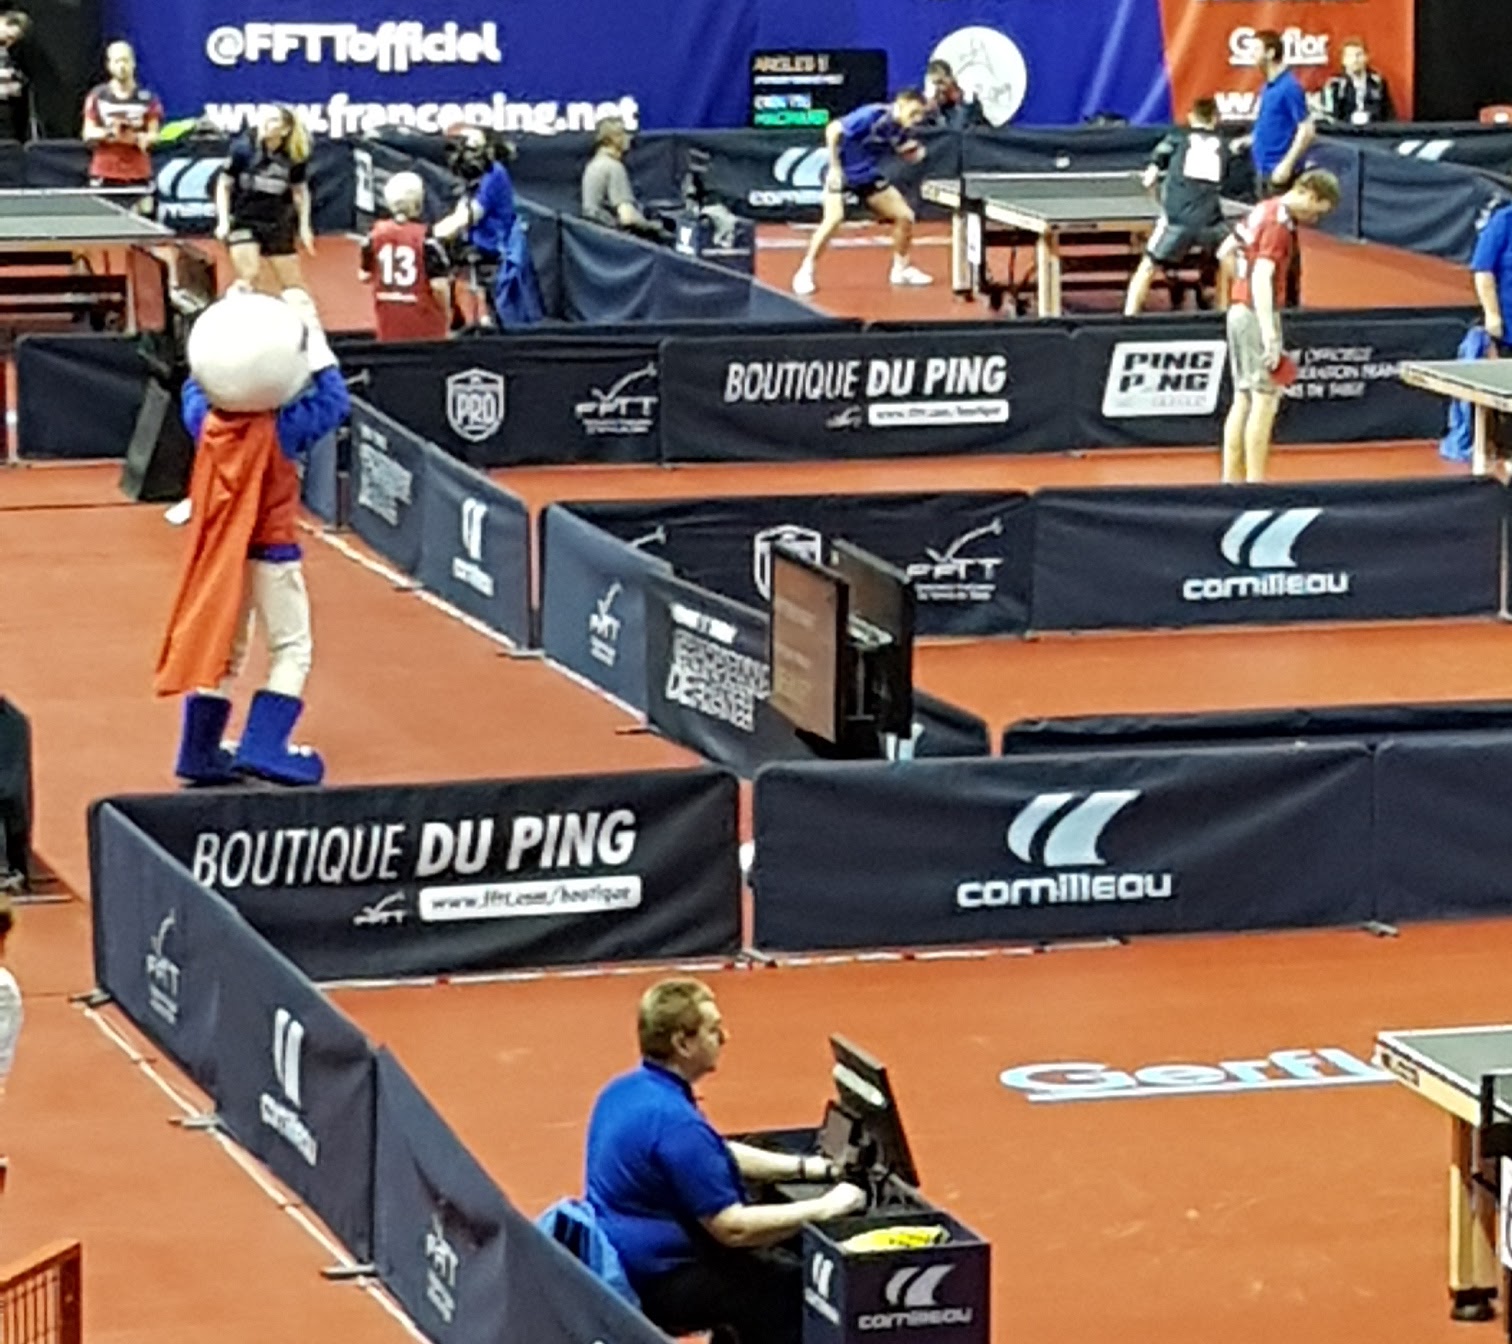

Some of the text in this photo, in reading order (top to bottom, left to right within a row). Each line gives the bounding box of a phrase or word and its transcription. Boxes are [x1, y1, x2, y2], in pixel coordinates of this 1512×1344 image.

[205, 22, 502, 71] @FFTTofficiel
[379, 243, 418, 286] 13
[724, 355, 1007, 403] BOUTIQUE DU PING
[1182, 570, 1349, 601] cornilleau
[194, 809, 637, 888] BOUTIQUE DU PING
[957, 872, 1173, 908] cornilleau
[1000, 1047, 1378, 1097] Gerfl
